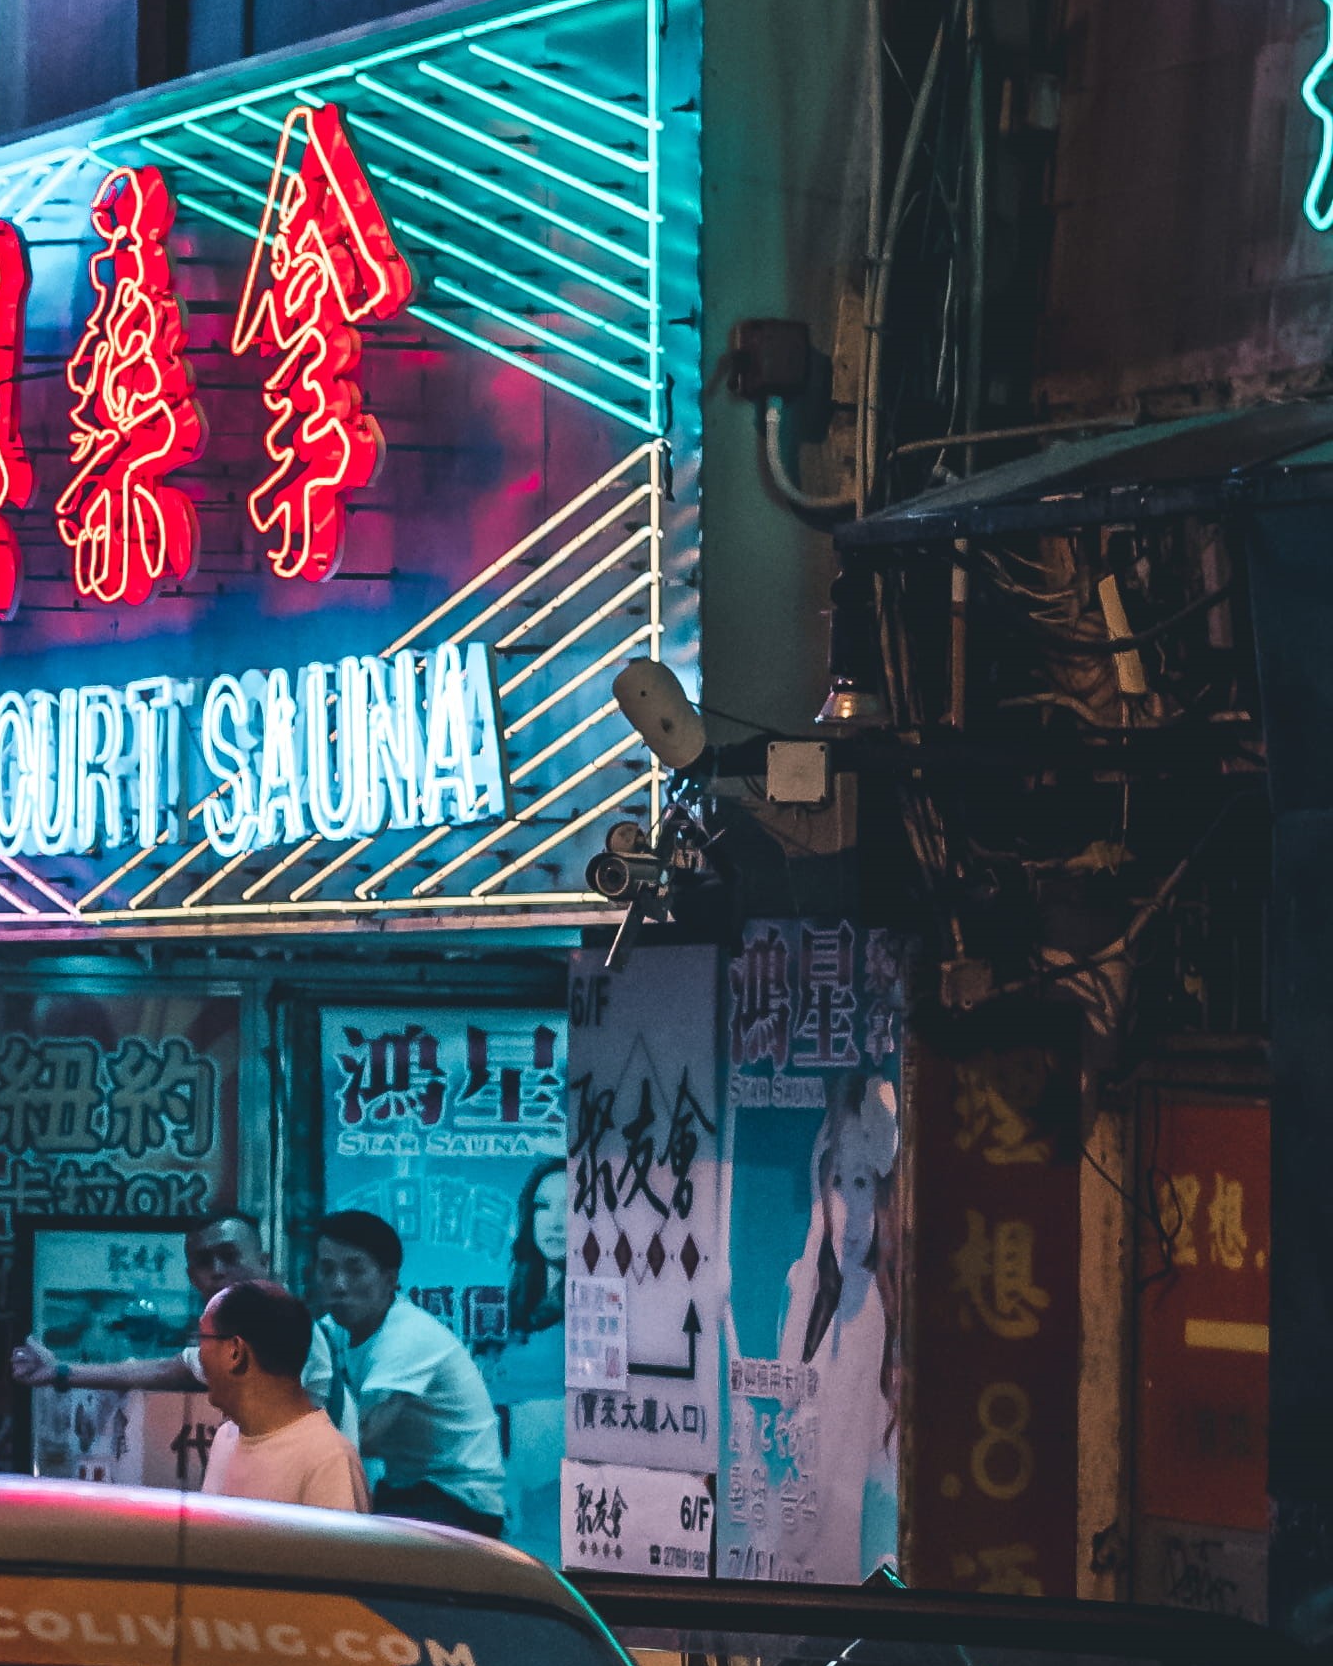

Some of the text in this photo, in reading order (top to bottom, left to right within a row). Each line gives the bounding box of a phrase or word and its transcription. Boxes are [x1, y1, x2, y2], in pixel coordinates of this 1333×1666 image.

[202, 641, 508, 859] SAUNA
[569, 976, 611, 1030] 6/F
[336, 1131, 536, 1158] STAR SAUNA
[680, 1495, 711, 1533] 6/F
